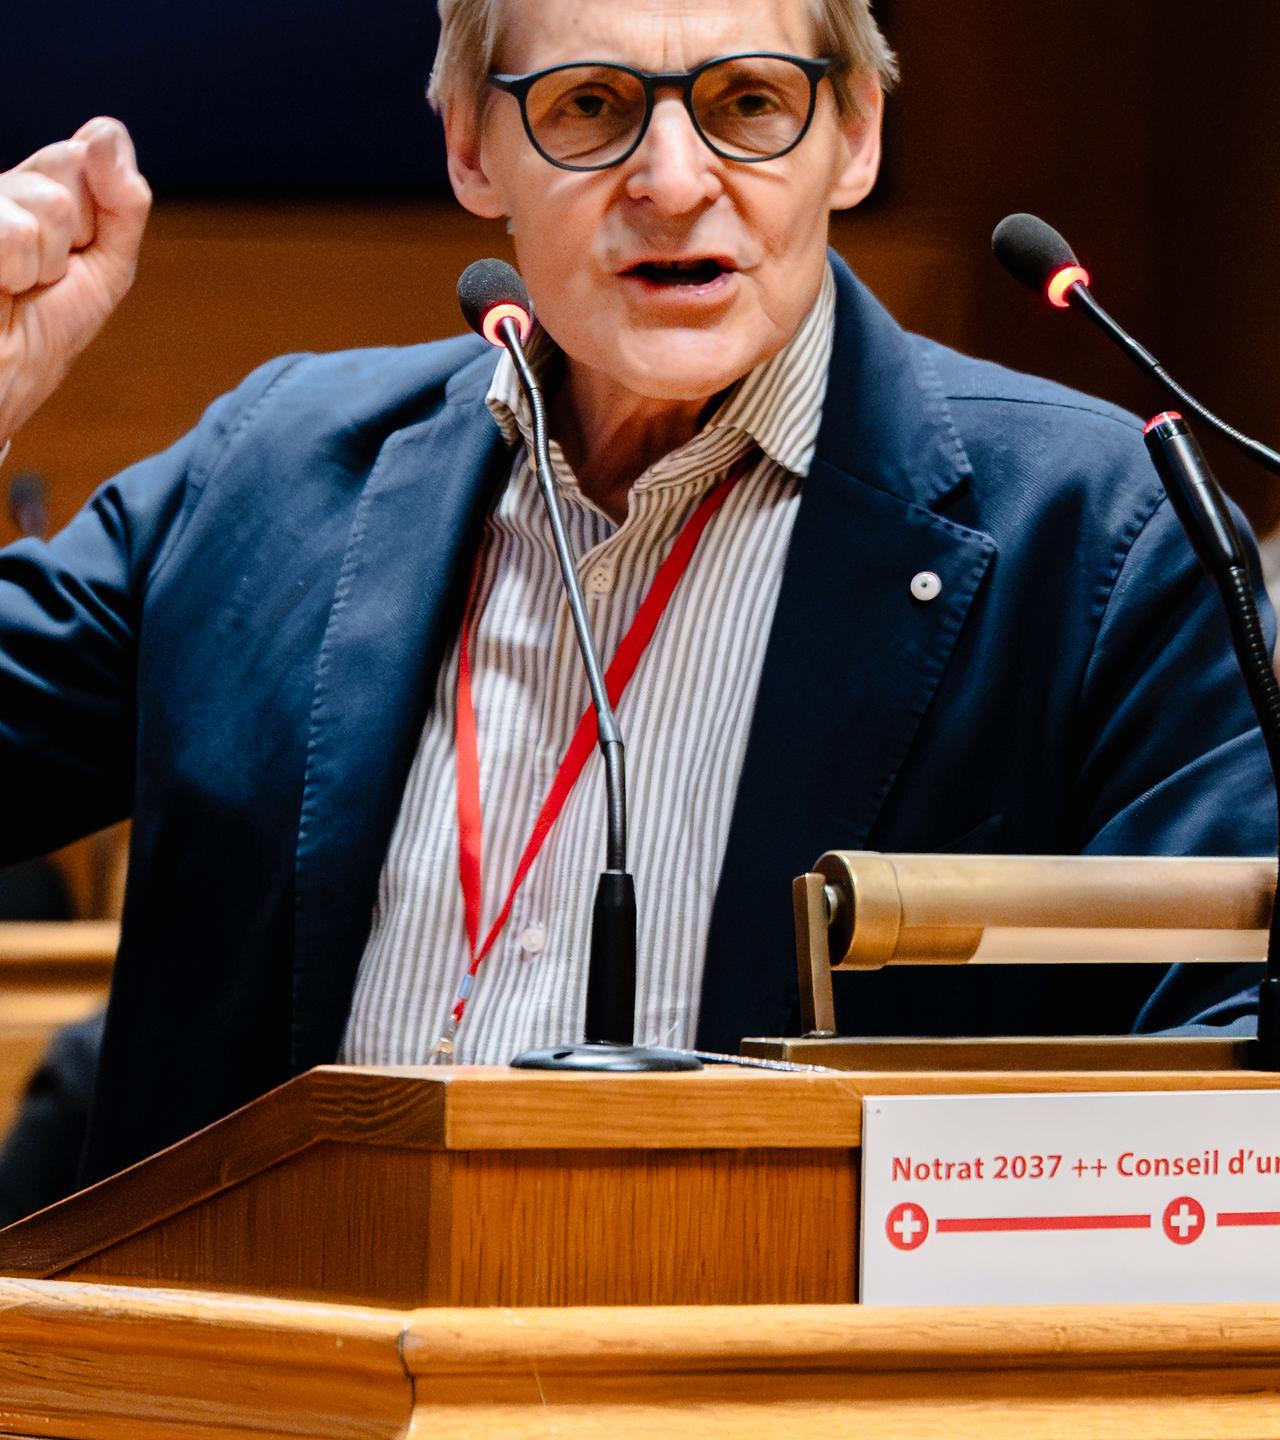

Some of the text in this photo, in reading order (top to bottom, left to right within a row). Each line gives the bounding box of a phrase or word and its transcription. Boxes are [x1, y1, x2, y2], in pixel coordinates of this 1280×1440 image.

[891, 1155, 984, 1183] Notrat
[993, 1153, 1063, 1181] 2037
[1115, 1148, 1221, 1178] Conseil
